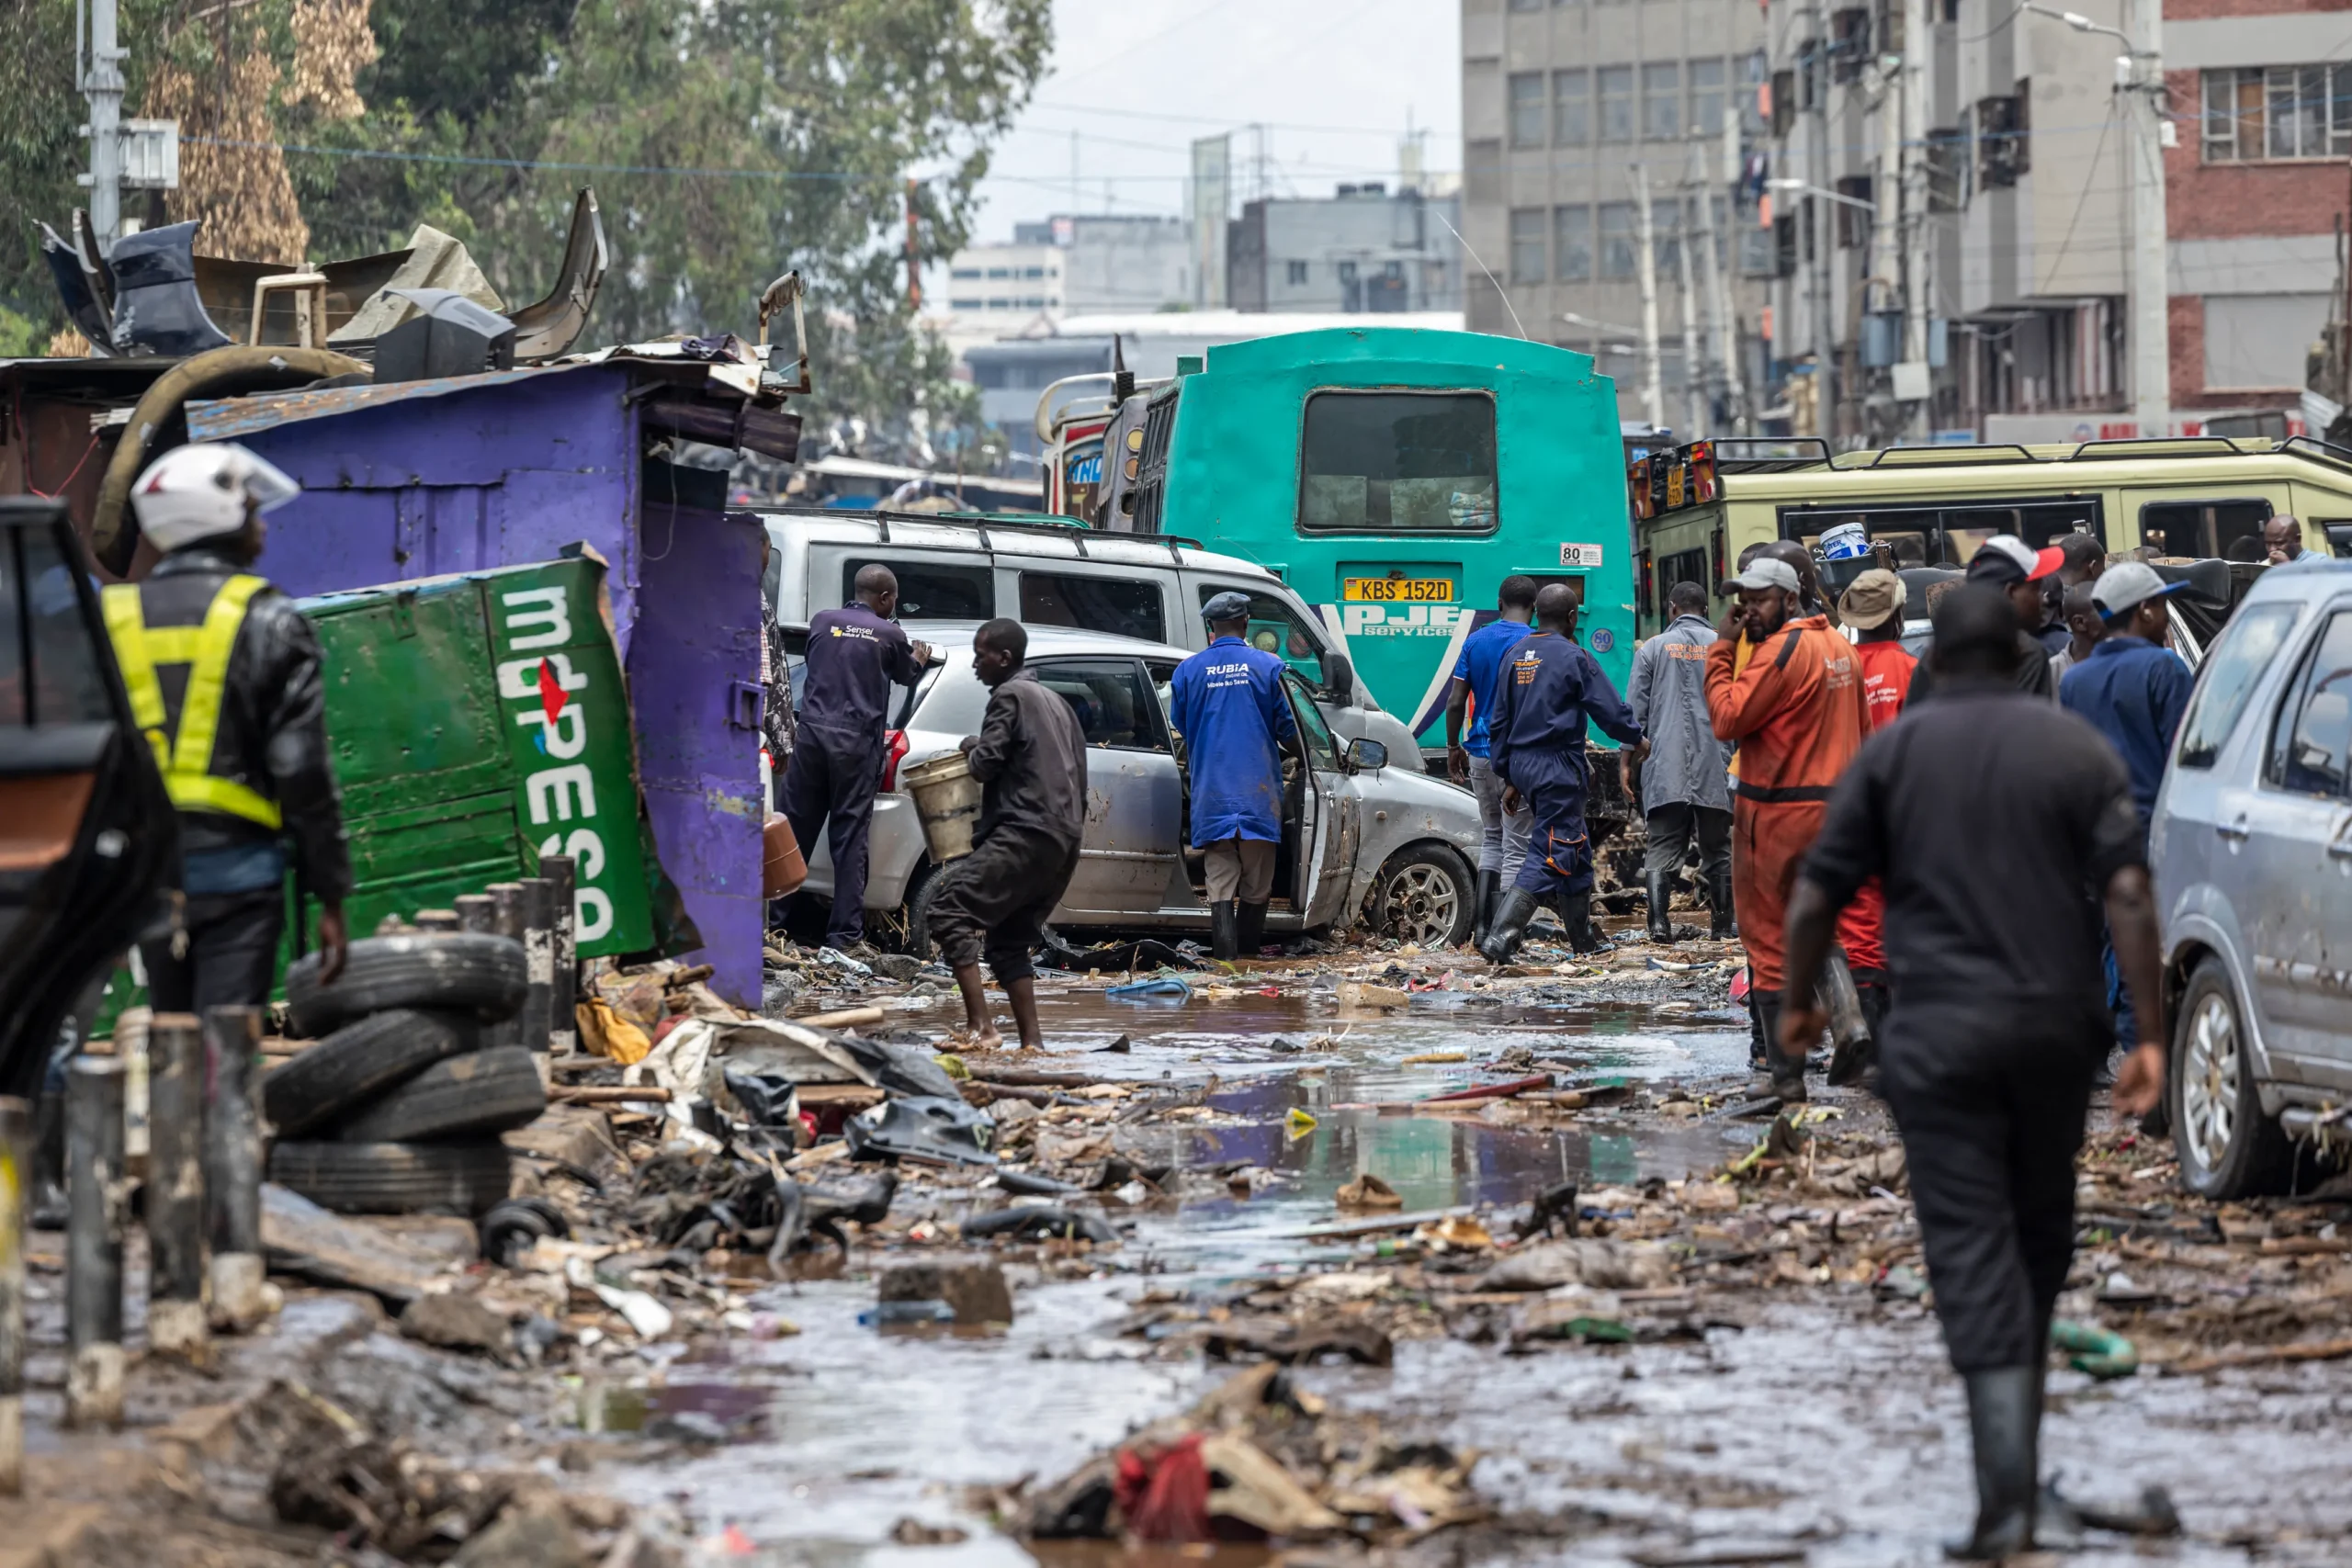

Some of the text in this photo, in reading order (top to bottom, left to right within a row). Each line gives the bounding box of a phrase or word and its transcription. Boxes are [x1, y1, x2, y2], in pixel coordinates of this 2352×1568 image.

[1564, 547, 1580, 559] 80
[1362, 581, 1447, 600] KBS 152D
[1343, 604, 1460, 637] PJE
[845, 625, 874, 635] Sensei
[1363, 626, 1454, 637] services
[1594, 633, 1611, 644] 80
